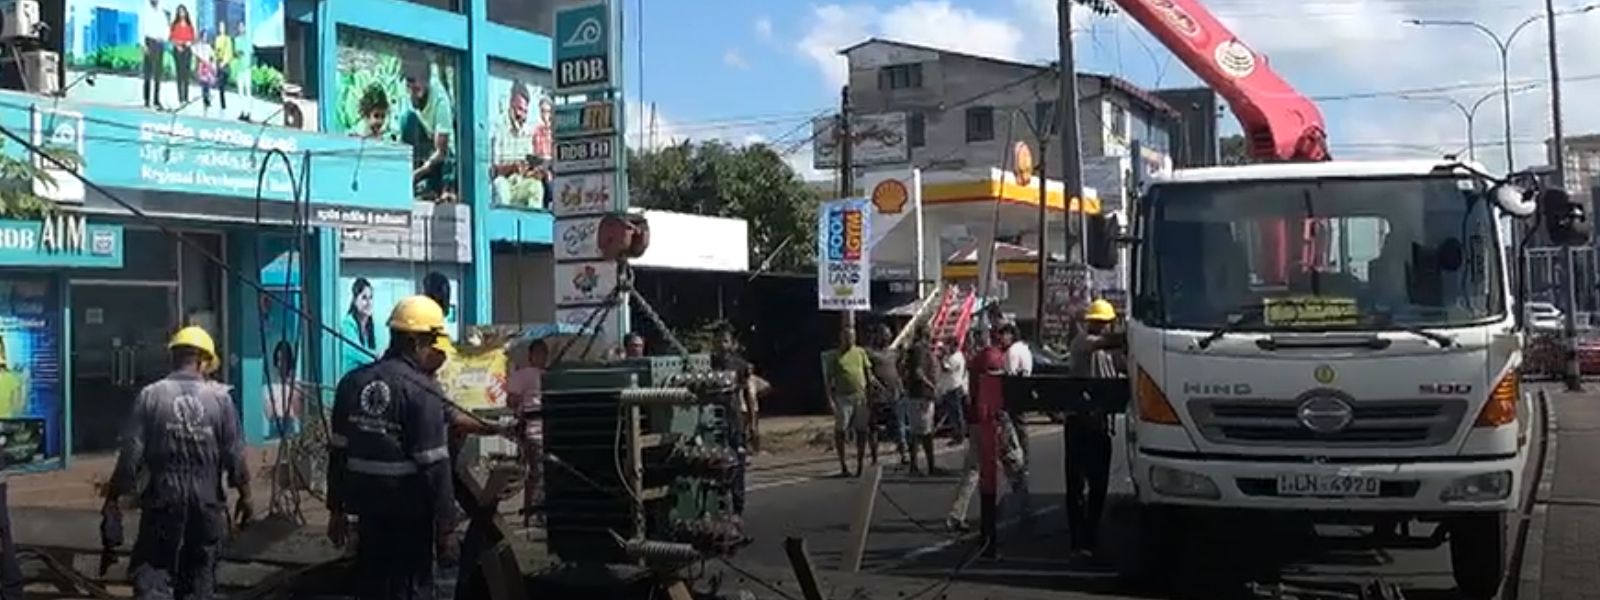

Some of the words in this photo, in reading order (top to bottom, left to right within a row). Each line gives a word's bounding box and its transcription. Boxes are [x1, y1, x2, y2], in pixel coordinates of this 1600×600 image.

[561, 57, 604, 84] RDB
[0, 228, 34, 249] DB
[1418, 383, 1473, 395] 500
